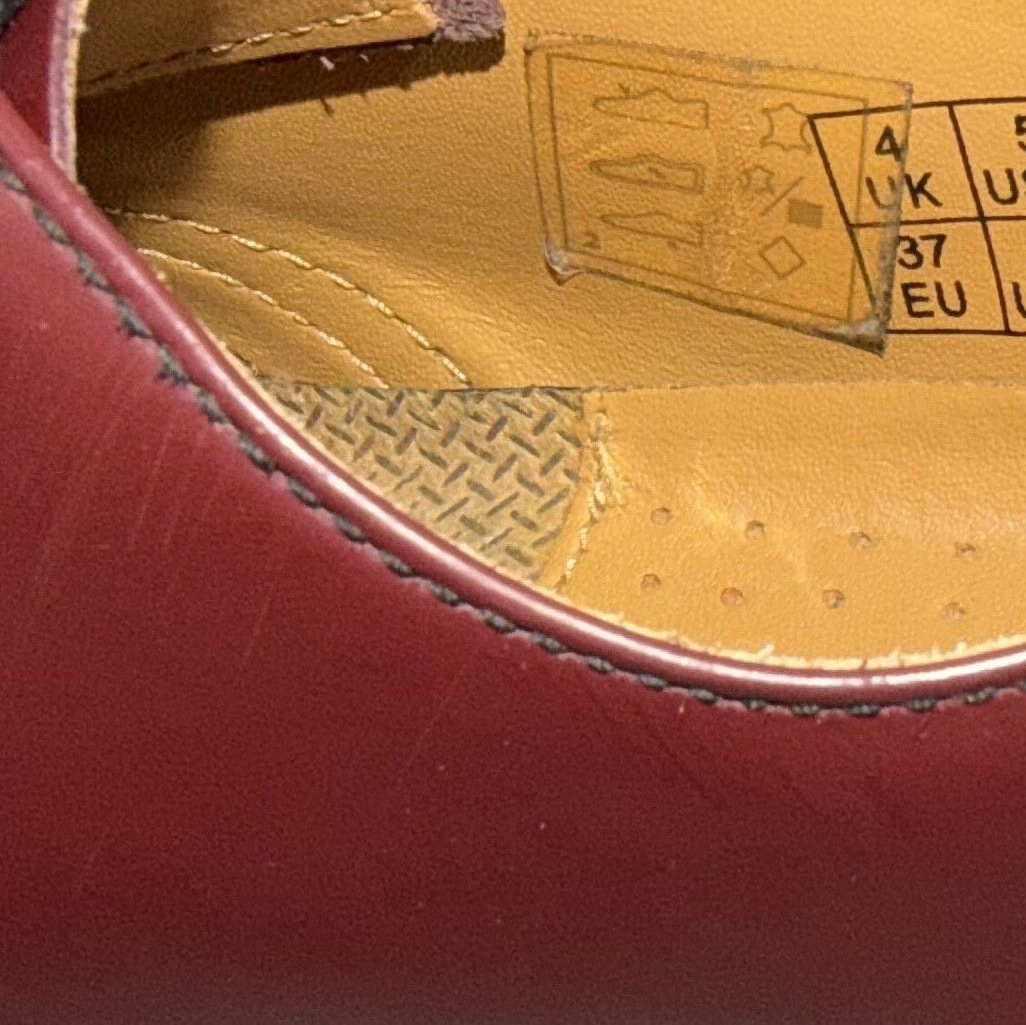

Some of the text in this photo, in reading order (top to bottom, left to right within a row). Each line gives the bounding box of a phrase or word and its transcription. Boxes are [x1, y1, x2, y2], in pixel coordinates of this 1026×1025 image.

[875, 125, 902, 162] 4
[865, 172, 943, 209] UK
[898, 234, 947, 270] 37
[901, 281, 967, 318] EU
